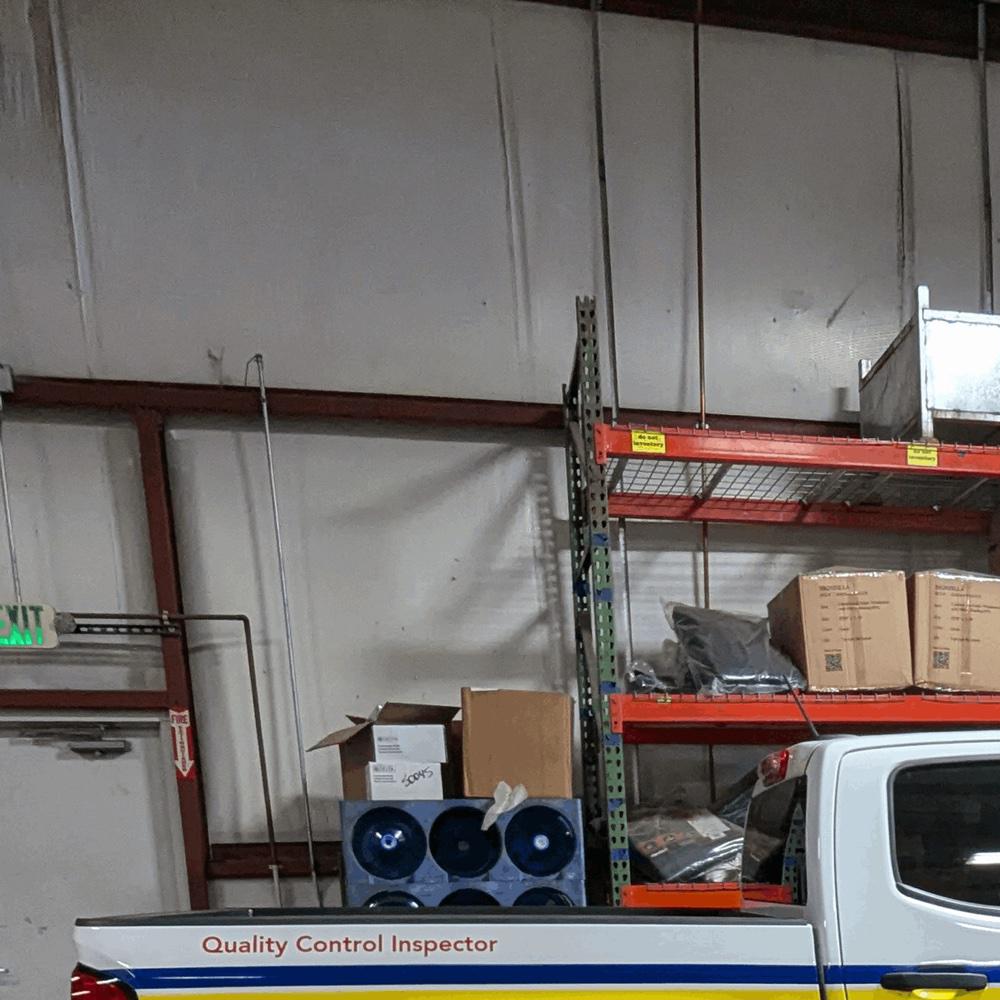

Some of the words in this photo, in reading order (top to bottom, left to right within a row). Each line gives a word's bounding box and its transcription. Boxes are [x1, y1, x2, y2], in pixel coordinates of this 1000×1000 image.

[202, 935, 288, 958] Quality
[296, 934, 383, 953] Control
[391, 935, 498, 957] Inspector
